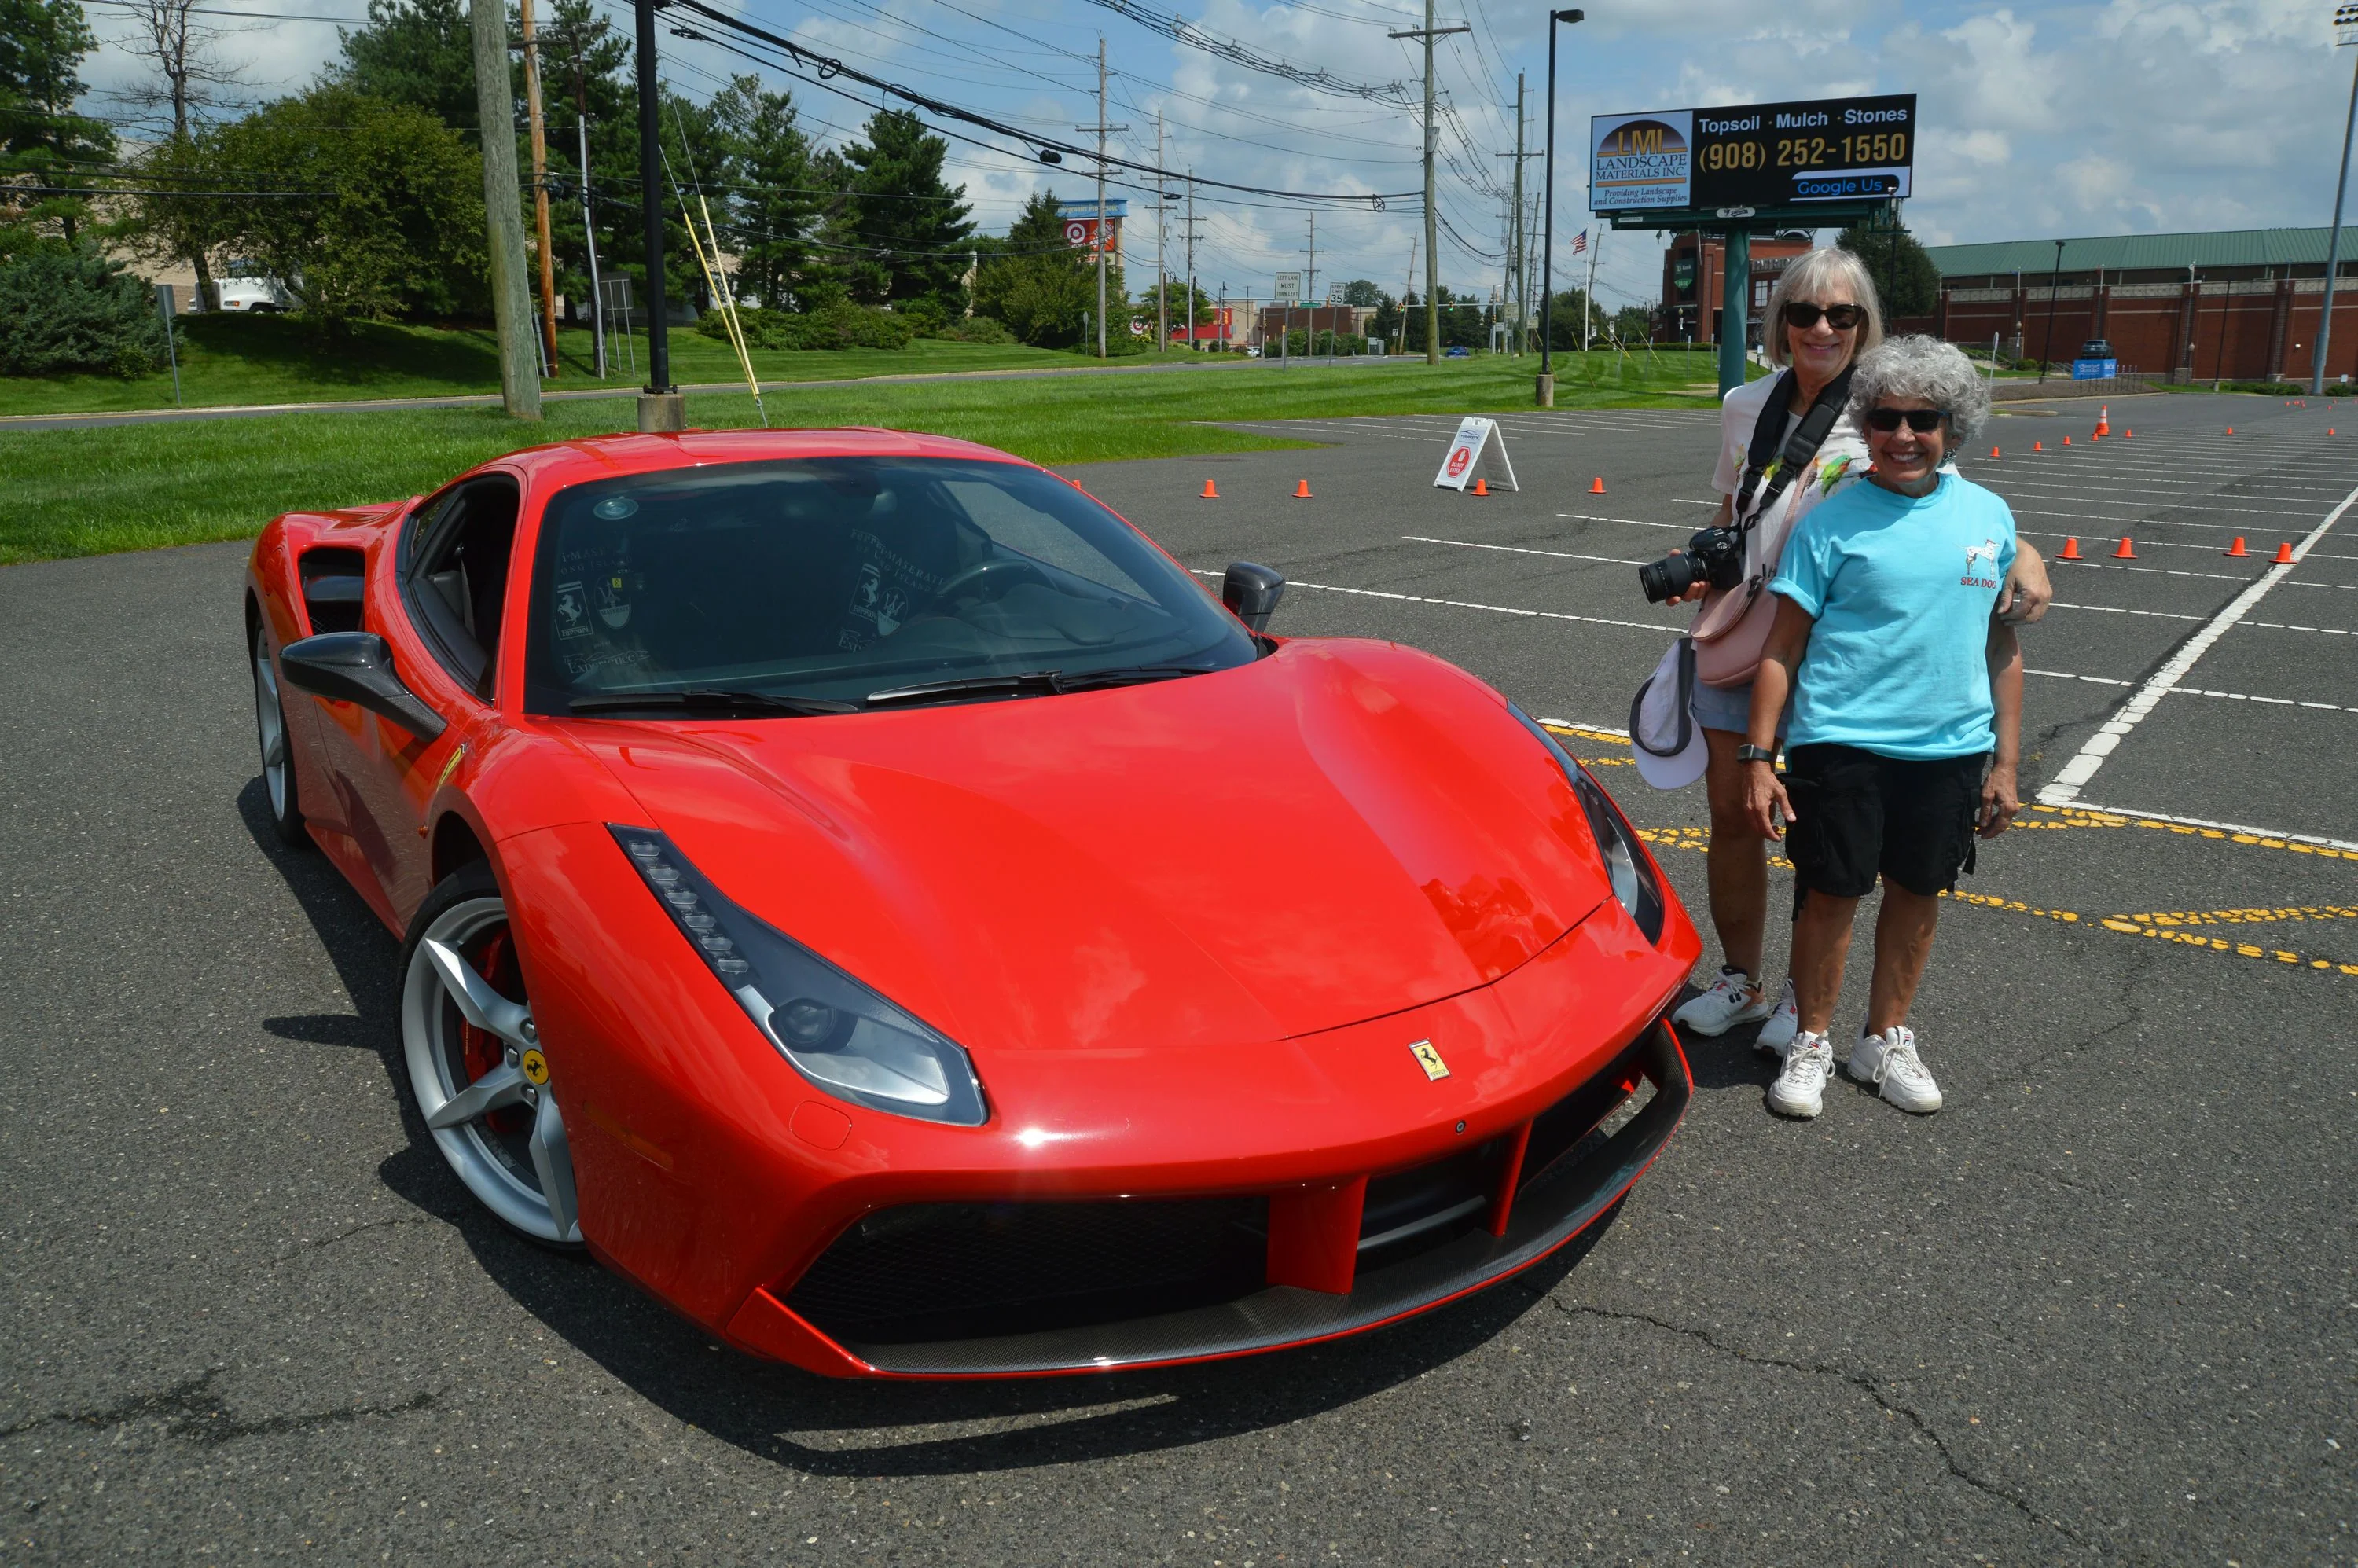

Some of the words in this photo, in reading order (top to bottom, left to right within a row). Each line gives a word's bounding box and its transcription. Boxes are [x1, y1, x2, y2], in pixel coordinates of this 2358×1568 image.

[1699, 115, 1760, 136] Topsoil
[1776, 111, 1828, 128] Mulch
[1844, 108, 1908, 124] Stones
[1617, 128, 1662, 156] LMI
[1699, 141, 1766, 174] (908)
[1776, 132, 1906, 167] 252-1550
[1596, 153, 1688, 171] LANDSCAPE
[1596, 167, 1660, 181] MATERIALS
[1662, 166, 1686, 178] INC.
[1604, 188, 1639, 198] Providing
[1641, 186, 1678, 196] Landscape
[1798, 178, 1857, 196] Google
[1861, 178, 1882, 192] Us
[1594, 197, 1607, 206] and
[1609, 196, 1655, 205] Construction
[1657, 193, 1688, 204] Supplies
[1330, 294, 1342, 303] 35
[1960, 576, 1979, 586] SEA
[561, 626, 590, 637] Ferrari
